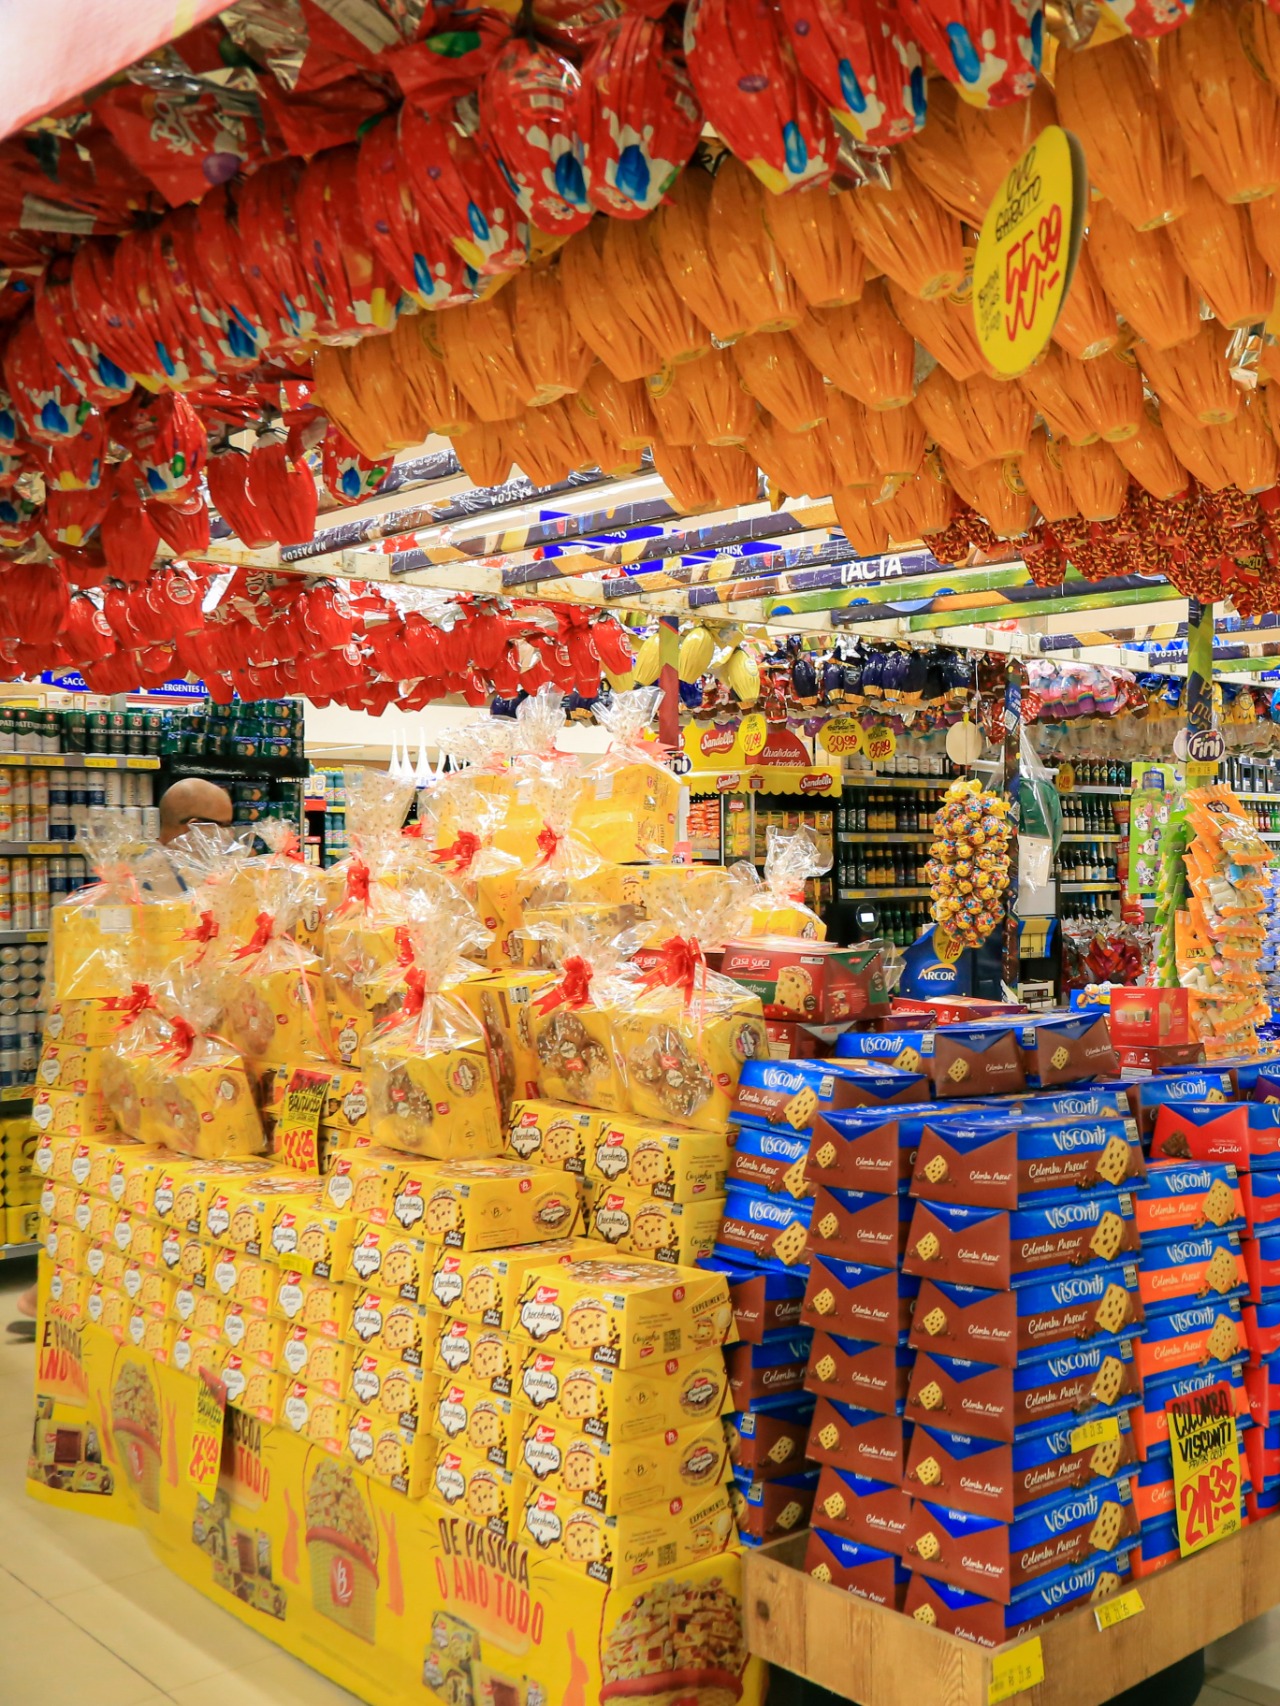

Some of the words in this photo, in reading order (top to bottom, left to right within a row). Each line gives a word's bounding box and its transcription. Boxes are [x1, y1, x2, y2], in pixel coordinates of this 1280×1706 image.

[1007, 146, 1036, 201] OVO
[152, 682, 200, 693] TERGENTES
[701, 730, 734, 748] Sandella
[1192, 736, 1221, 758] Fini
[763, 747, 800, 758] Qualidade
[717, 773, 740, 788] Sandella
[801, 774, 832, 788] Sandella
[730, 957, 749, 968] Casa
[918, 968, 956, 981] ARCOR
[861, 1035, 903, 1054] Visconti
[763, 1069, 804, 1091] Visconti
[1166, 1079, 1206, 1099] Visconti
[1053, 1097, 1099, 1115] Visconti
[761, 1136, 804, 1159] Visconti
[1052, 1125, 1106, 1151] Visconti
[970, 1170, 991, 1181] Colomba
[1028, 1162, 1062, 1178] Colomba
[1165, 1170, 1211, 1193] Visconti
[750, 1200, 793, 1225] Visconti
[1045, 1201, 1099, 1230] Visconti
[958, 1248, 979, 1260] Colomba
[1021, 1243, 1055, 1258] Colomba
[1167, 1238, 1213, 1263] Visconti
[1052, 1274, 1104, 1304] Visconti
[522, 1306, 560, 1323] Chocolomba
[1170, 1307, 1214, 1333] Visconti
[968, 1324, 990, 1336] Colomba
[1028, 1319, 1060, 1335] Colomba
[1048, 1349, 1100, 1377] Visconti
[962, 1398, 983, 1410] Colomba
[1172, 1390, 1230, 1439] COLOMBA
[1179, 1421, 1231, 1462] VISCONTI
[1024, 1469, 1056, 1489] Colomba
[1044, 1494, 1098, 1533] Visconti
[439, 1518, 461, 1555] DE
[1021, 1549, 1054, 1569] Colomba
[1041, 1568, 1095, 1605] Visconti
[435, 1556, 447, 1599] O
[454, 1556, 488, 1608] ANO
[494, 1573, 543, 1645] TODO
